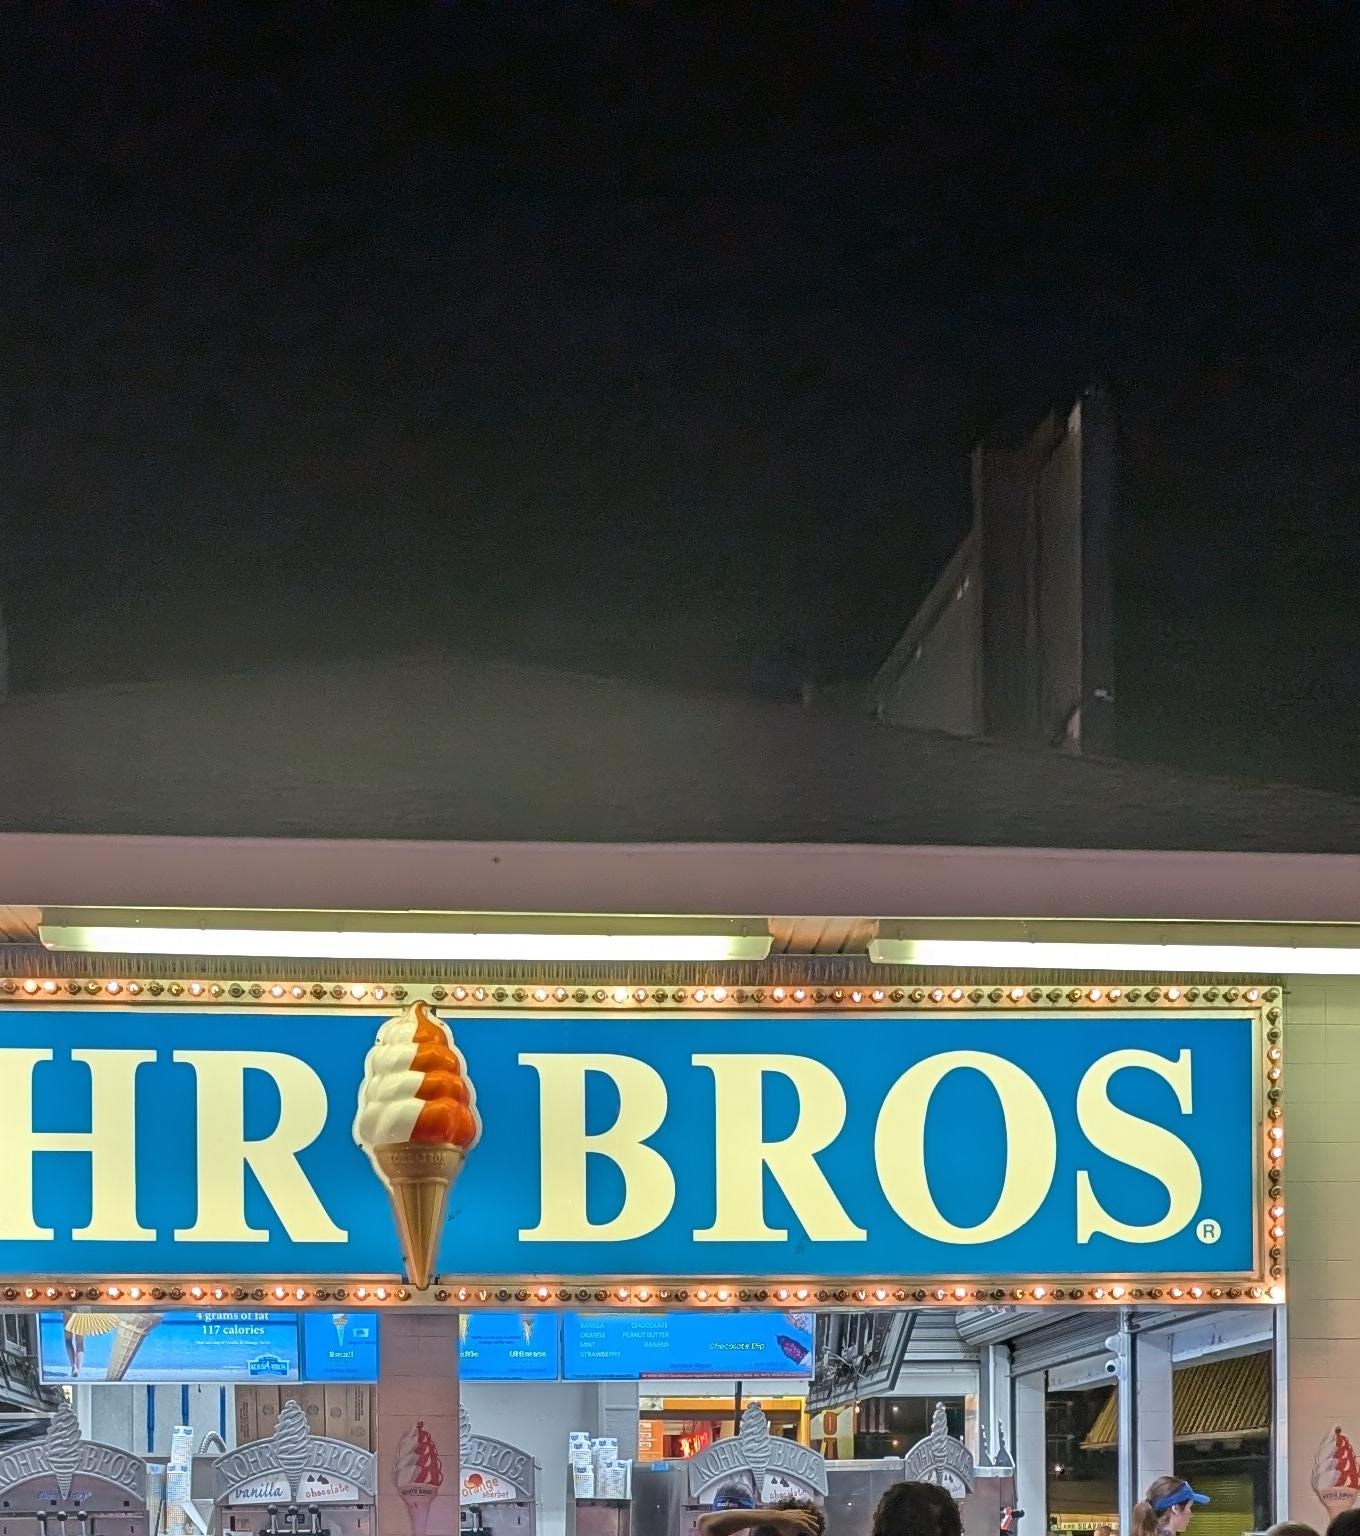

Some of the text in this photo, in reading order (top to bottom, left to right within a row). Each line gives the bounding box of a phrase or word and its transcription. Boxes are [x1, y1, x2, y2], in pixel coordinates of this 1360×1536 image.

[518, 1048, 1203, 1246] BROS
[205, 1313, 238, 1322] grams
[202, 1324, 265, 1335] 117 calories
[216, 1443, 280, 1487] KOHR
[693, 1442, 744, 1482] KOHR
[235, 1480, 284, 1499] vanilla
[305, 1484, 350, 1498] chocolate
[461, 1476, 500, 1498] orange
[482, 1489, 509, 1499] sherbet
